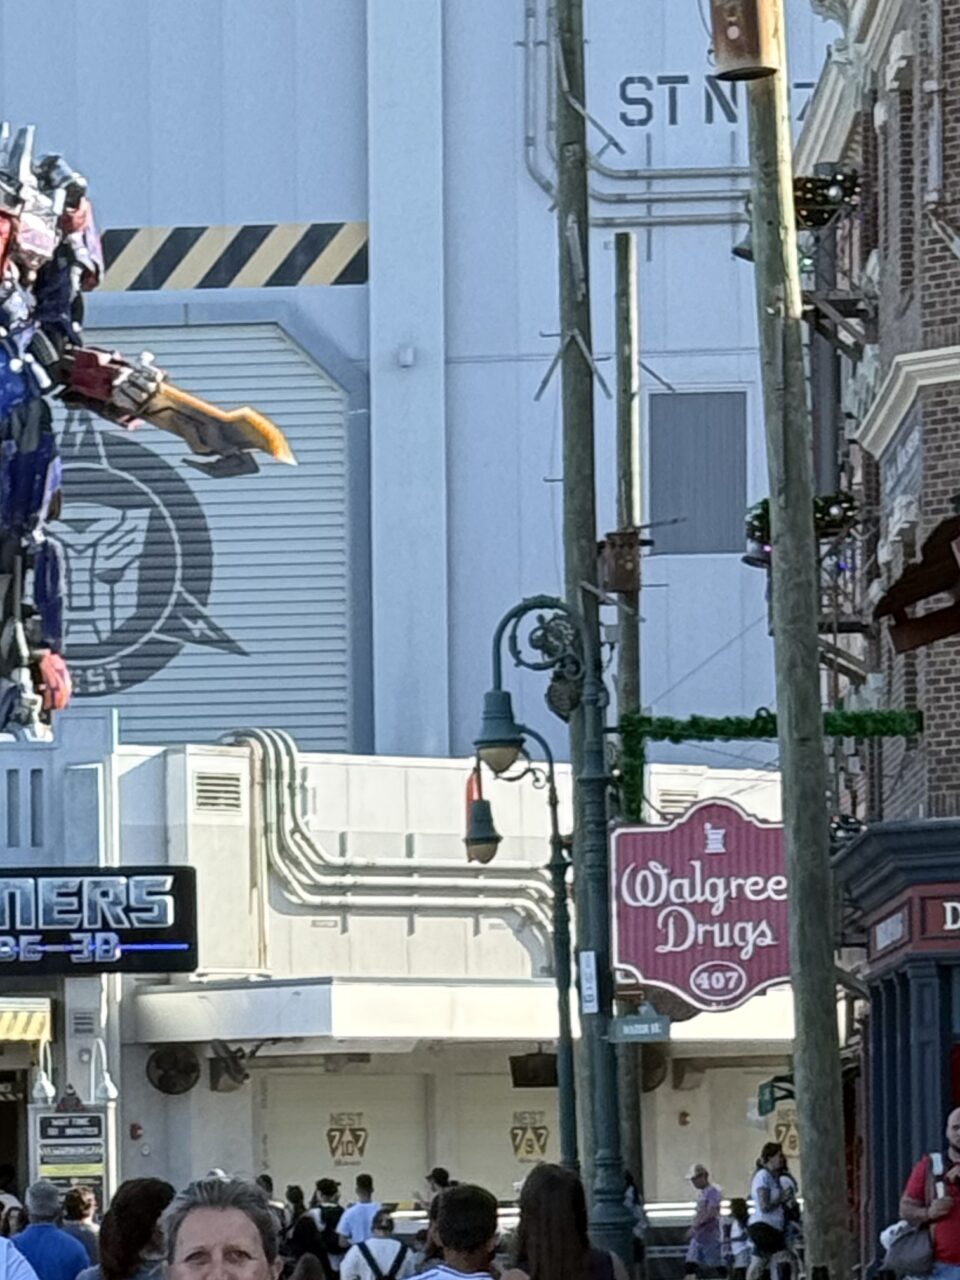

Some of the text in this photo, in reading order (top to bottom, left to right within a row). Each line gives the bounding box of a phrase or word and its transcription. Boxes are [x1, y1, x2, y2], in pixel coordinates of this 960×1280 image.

[69, 931, 121, 963] 3D
[654, 905, 781, 961] Drugs
[695, 971, 740, 990] 407
